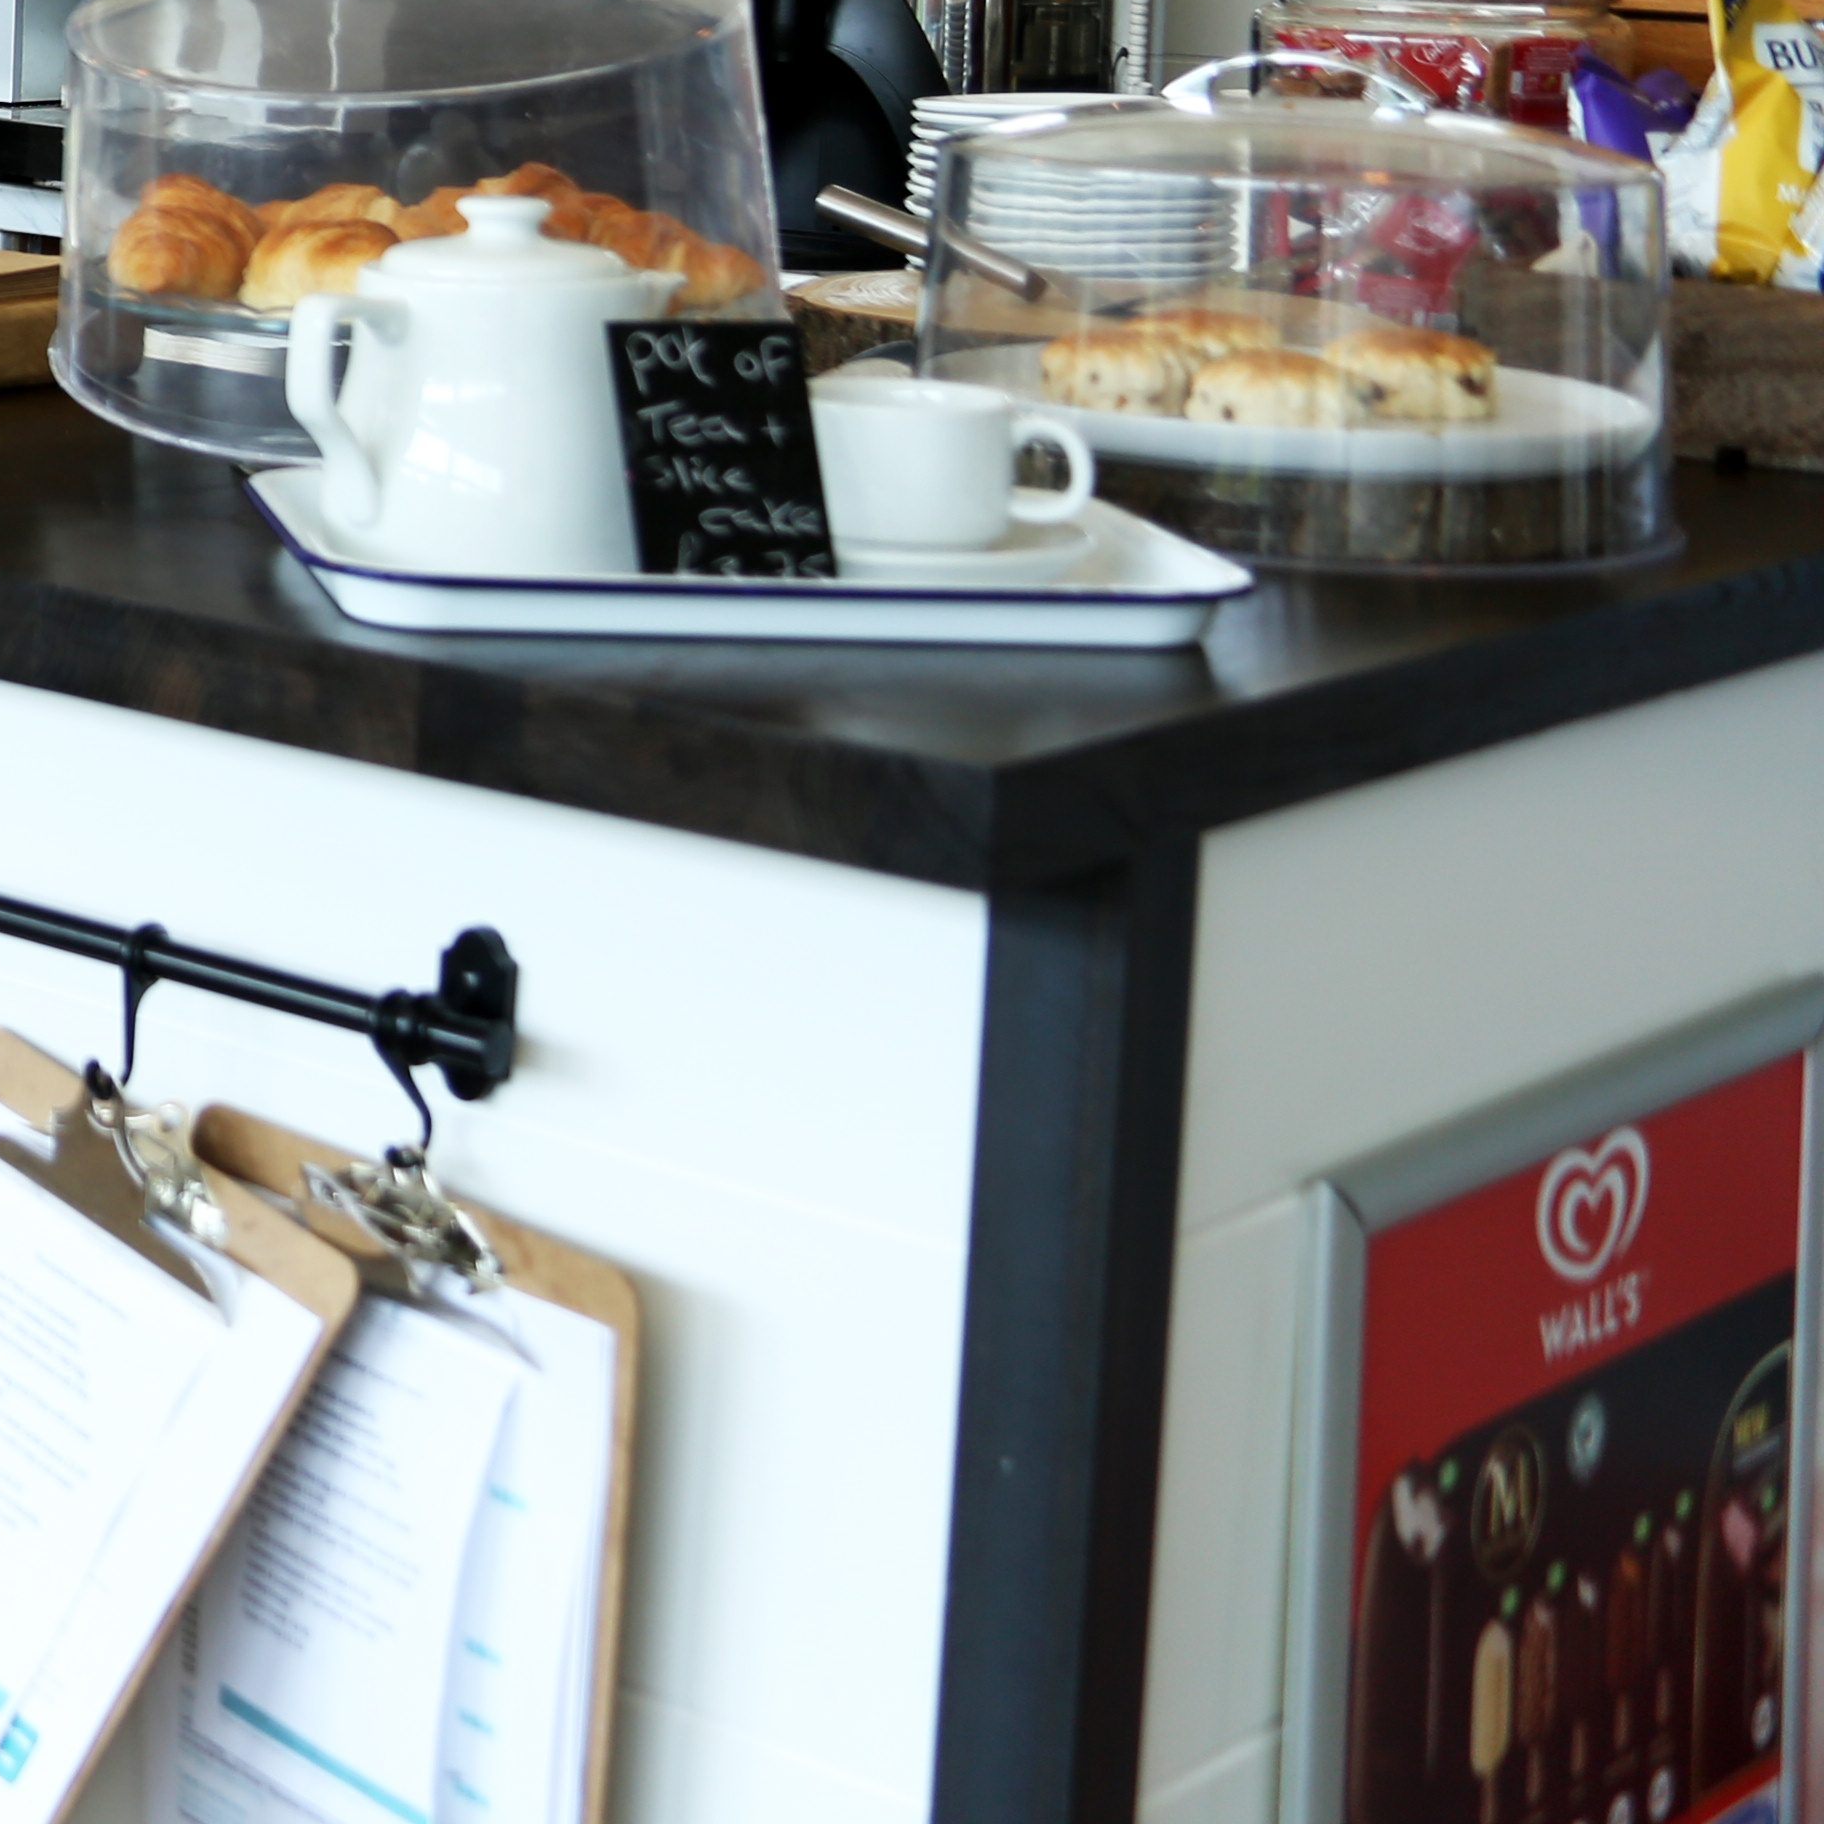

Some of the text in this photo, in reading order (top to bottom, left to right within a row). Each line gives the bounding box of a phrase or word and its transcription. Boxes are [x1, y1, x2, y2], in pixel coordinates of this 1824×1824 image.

[625, 323, 715, 395] Pot
[636, 399, 788, 449] Tea +
[1538, 1271, 1641, 1366] WALL'S
